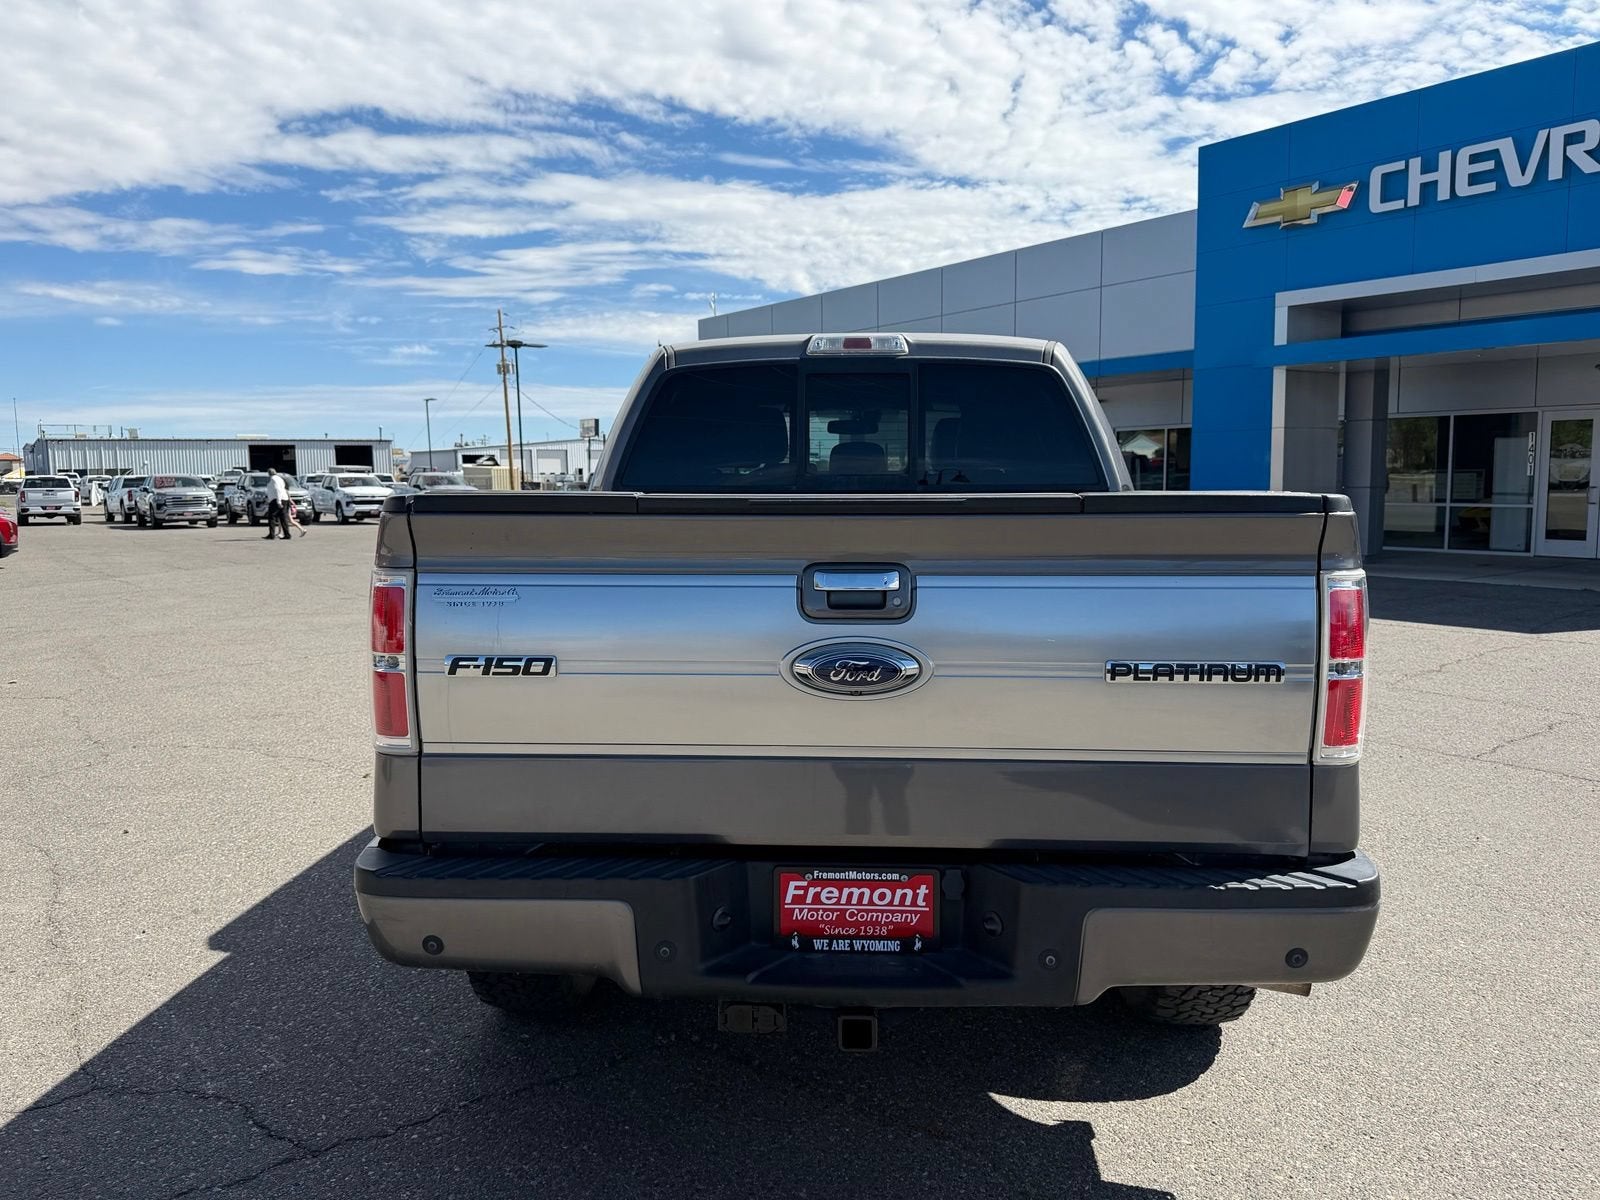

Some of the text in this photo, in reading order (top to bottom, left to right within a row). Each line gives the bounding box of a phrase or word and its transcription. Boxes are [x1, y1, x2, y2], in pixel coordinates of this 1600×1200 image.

[1368, 118, 1600, 214] CHEVR
[1527, 432, 1535, 475] 1401
[447, 656, 554, 676] F-150
[829, 659, 882, 682] Ford
[1109, 663, 1282, 682] PLATINUM
[813, 870, 900, 881] FremontMotors.com
[784, 881, 929, 906] Fremont
[793, 908, 920, 926] Motor Company
[813, 939, 901, 952] WE ARE WYOMING
